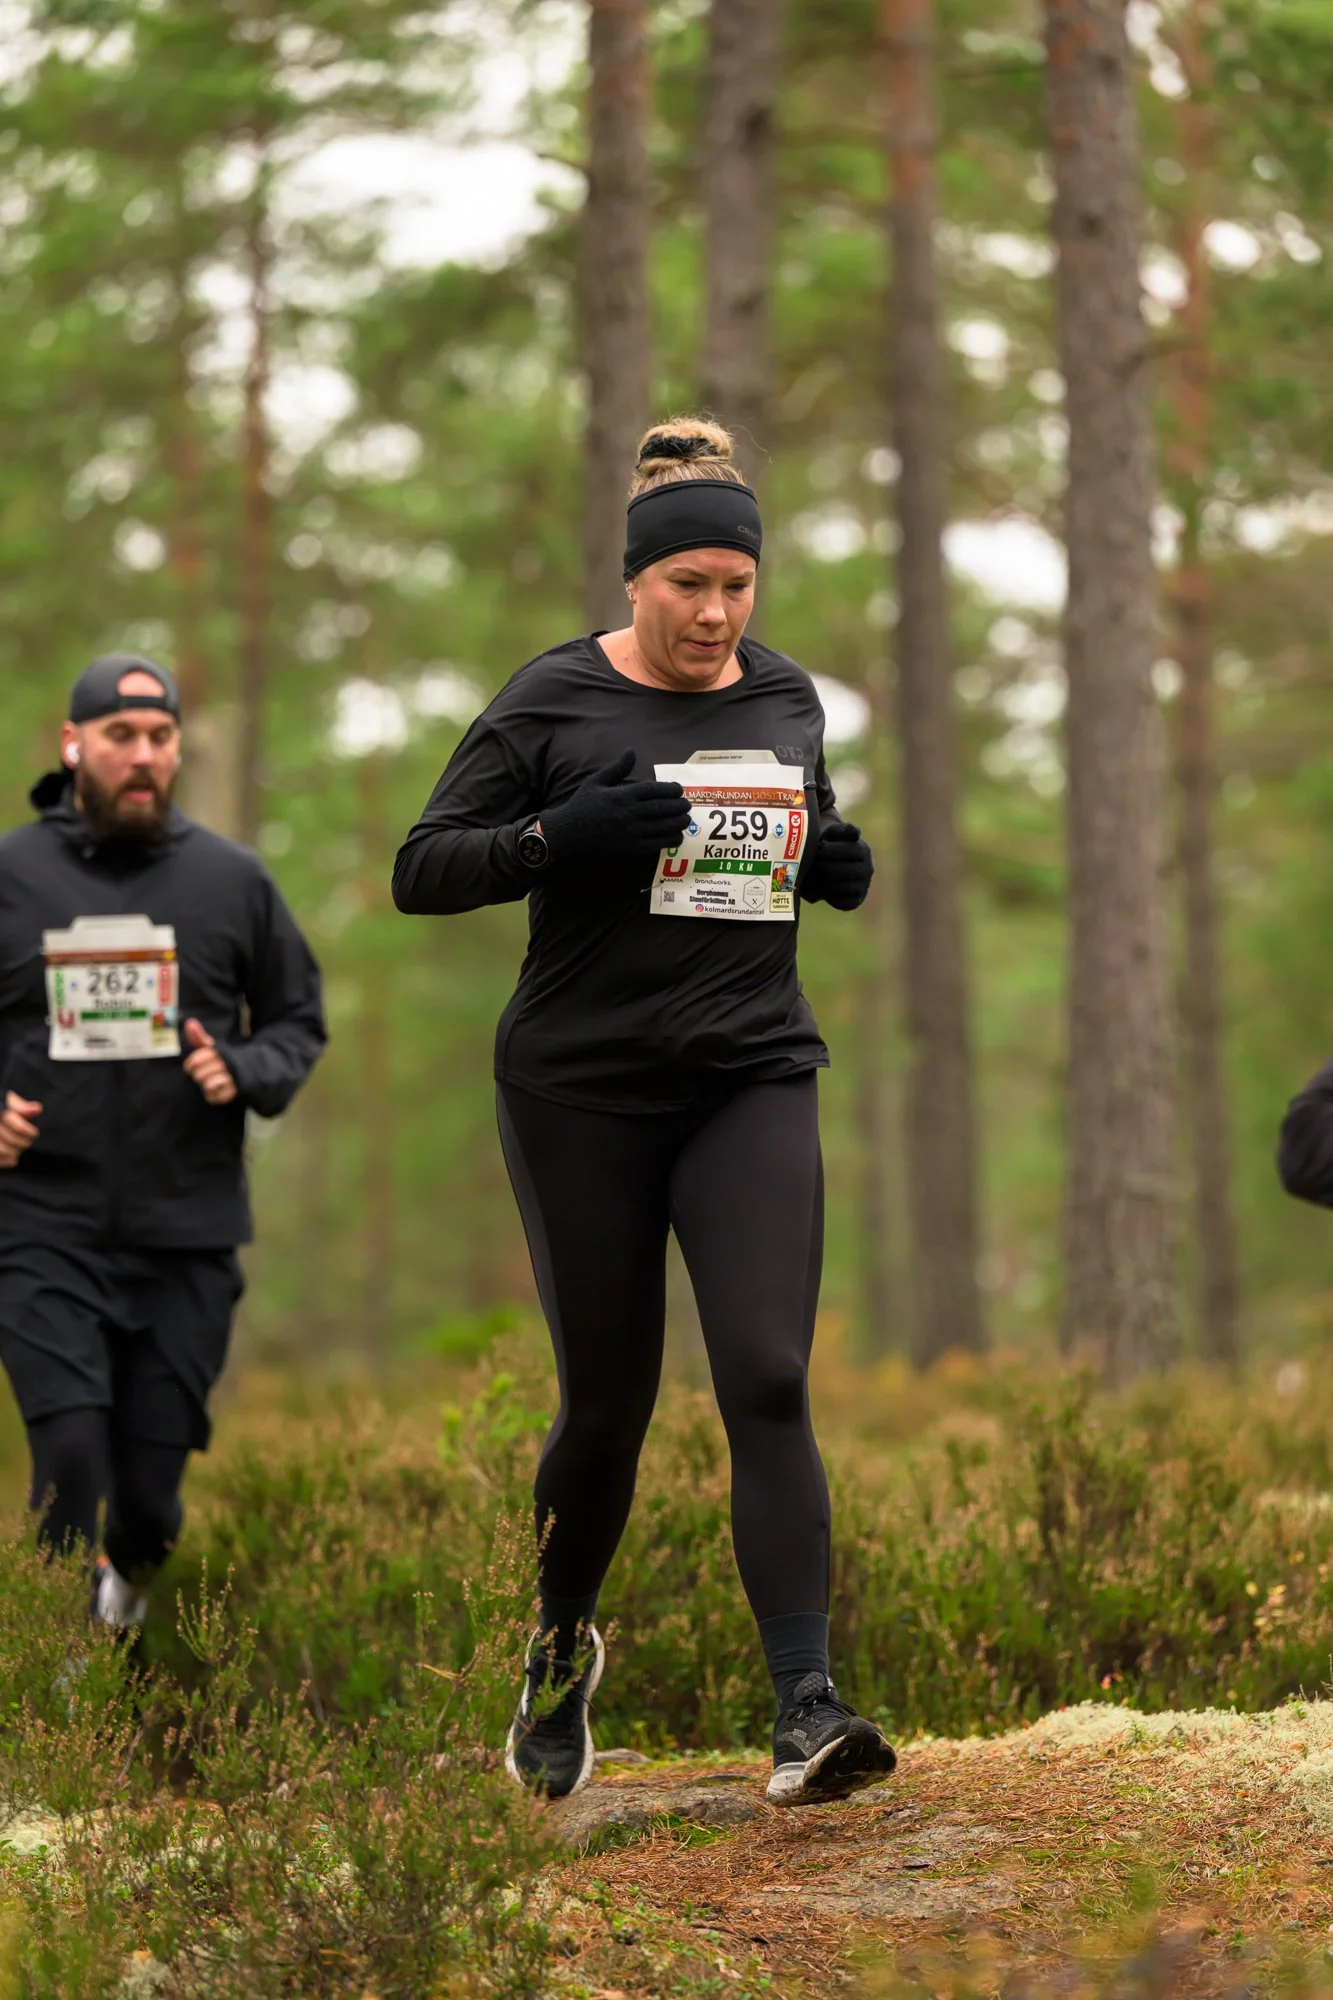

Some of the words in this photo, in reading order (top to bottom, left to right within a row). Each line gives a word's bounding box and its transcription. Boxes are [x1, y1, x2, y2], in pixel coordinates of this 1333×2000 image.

[708, 810, 768, 841] 259
[703, 844, 769, 860] Karoline
[788, 828, 799, 856] CIRCLE
[719, 861, 732, 871] 10
[739, 862, 753, 872] KM
[88, 967, 141, 996] 262
